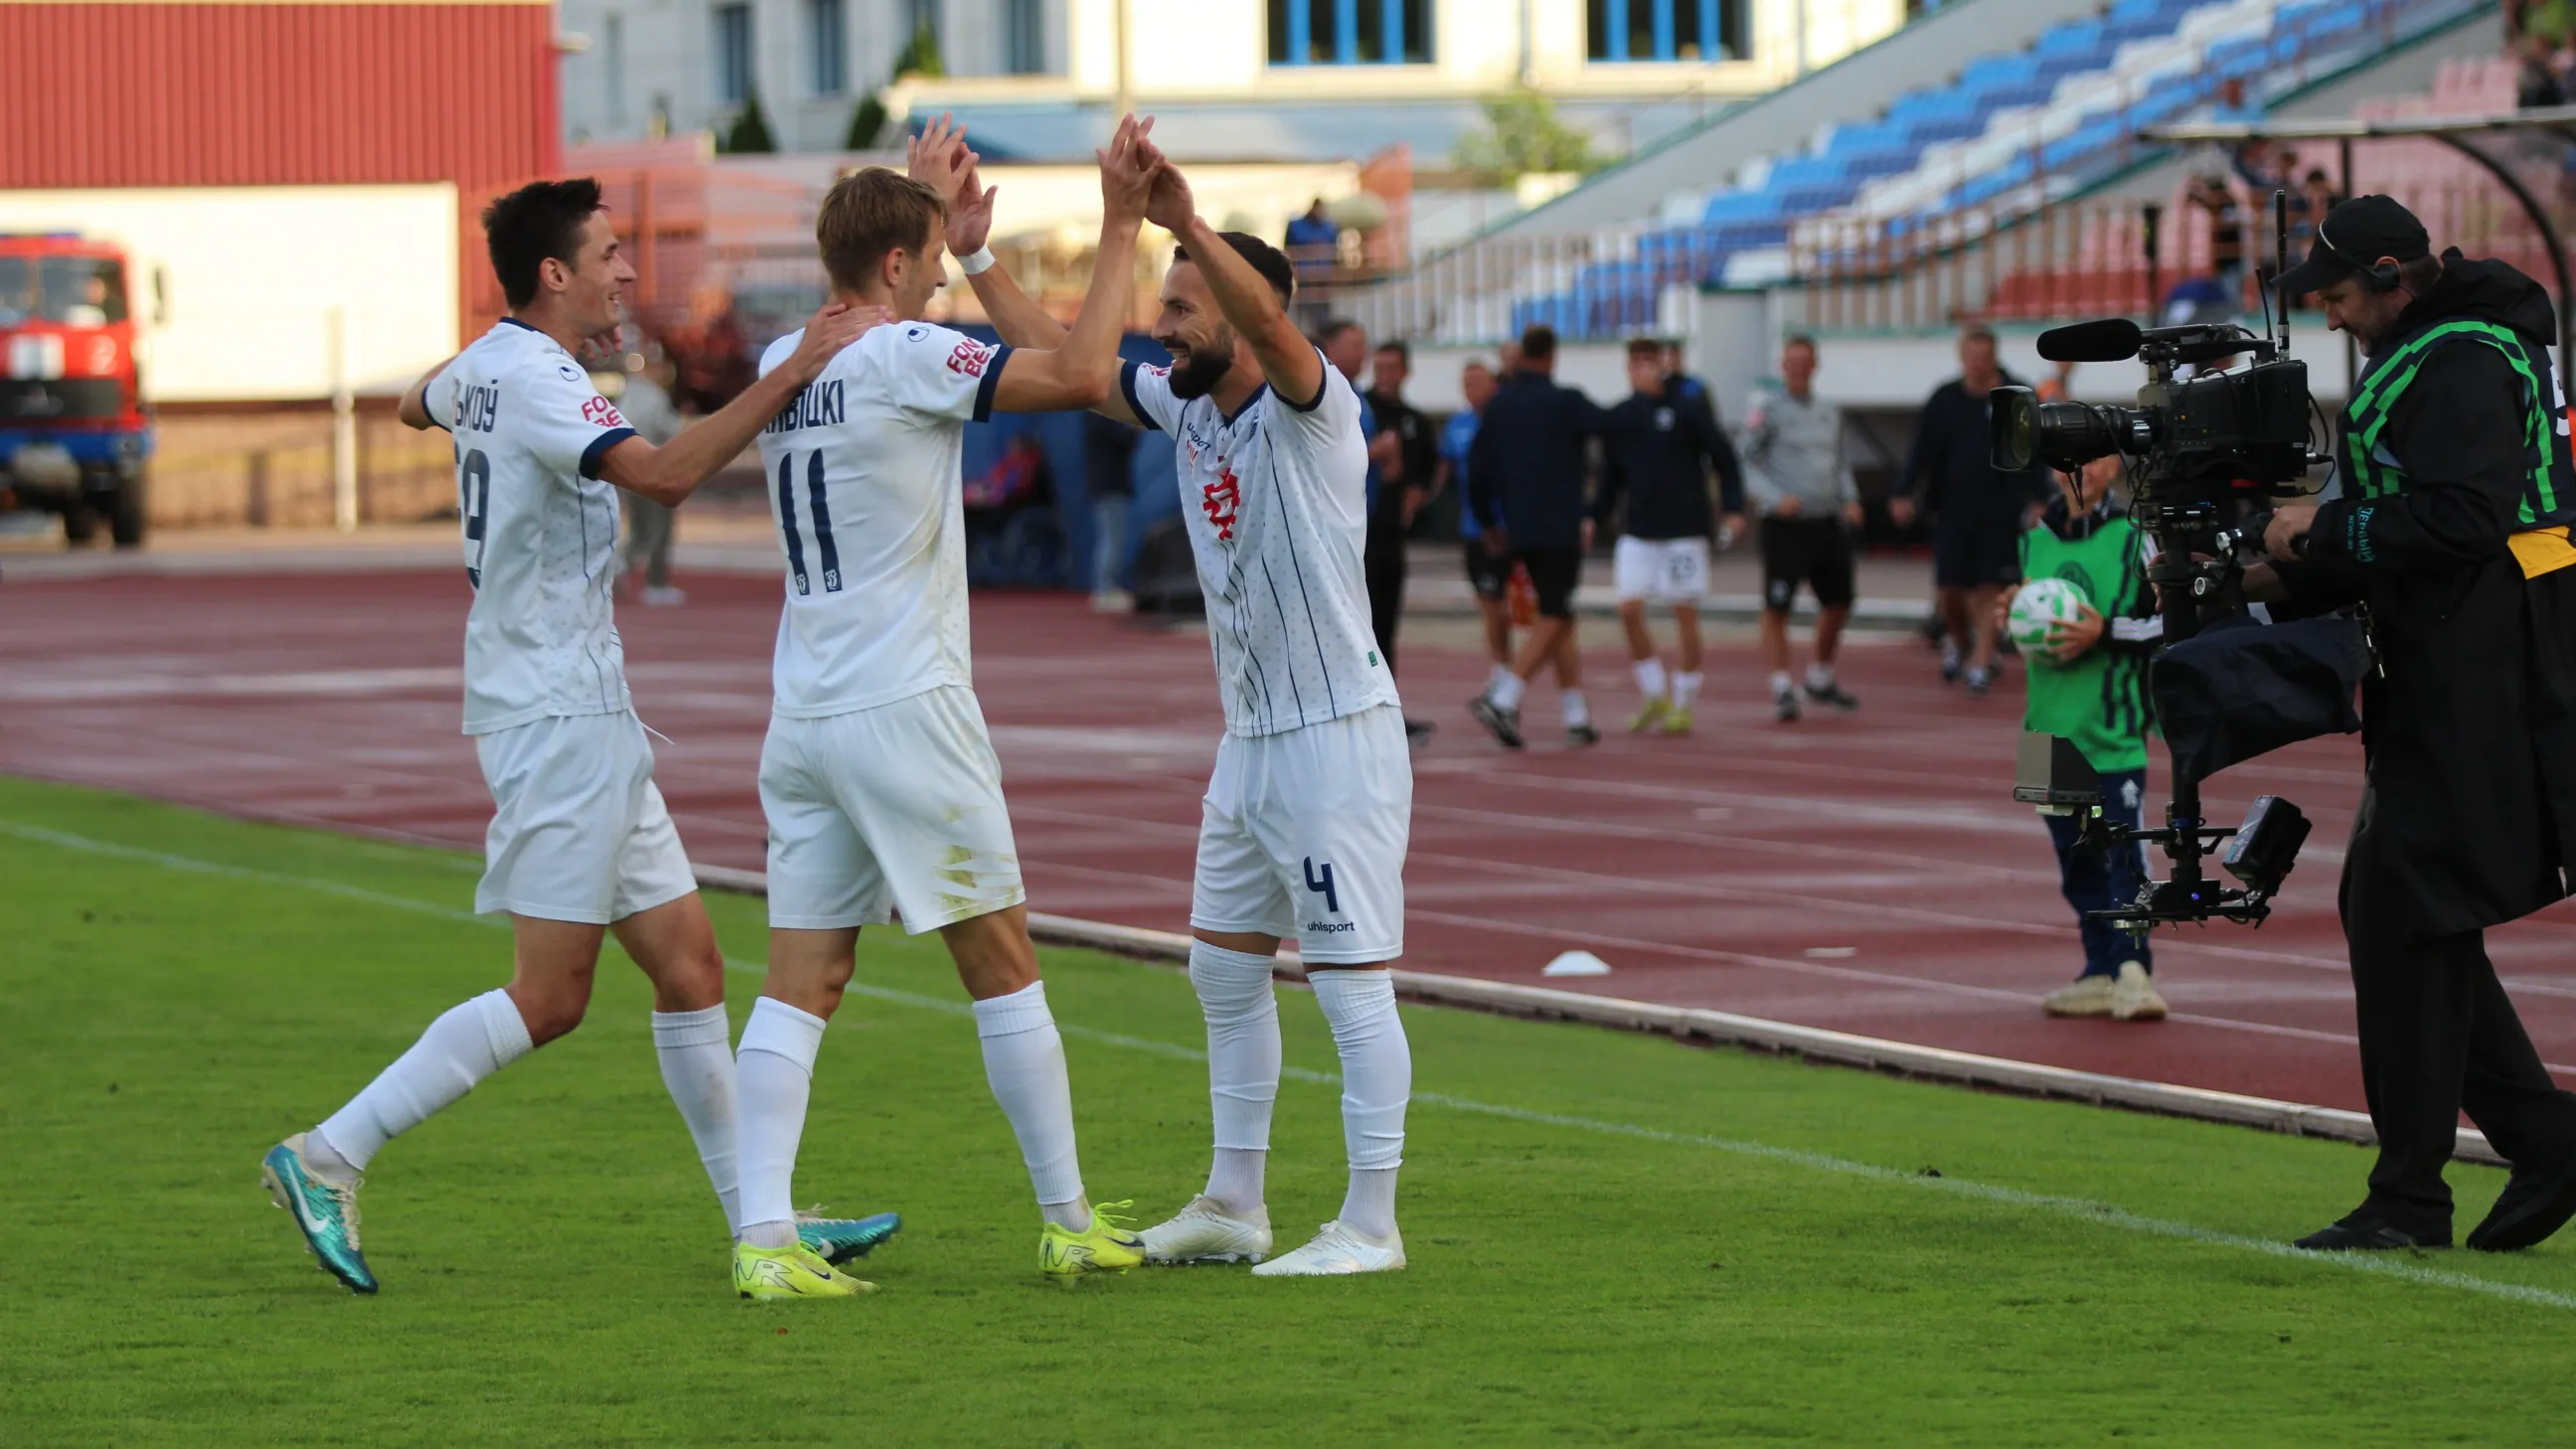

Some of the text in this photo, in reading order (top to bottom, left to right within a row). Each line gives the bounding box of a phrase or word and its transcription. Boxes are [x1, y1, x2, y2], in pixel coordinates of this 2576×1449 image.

[946, 337, 982, 375] FON
[964, 349, 992, 379] BE
[581, 396, 607, 422] FO
[454, 441, 490, 589] 9
[778, 447, 843, 596] 11
[1303, 856, 1339, 912] 4
[1307, 920, 1356, 934] uhlsport
